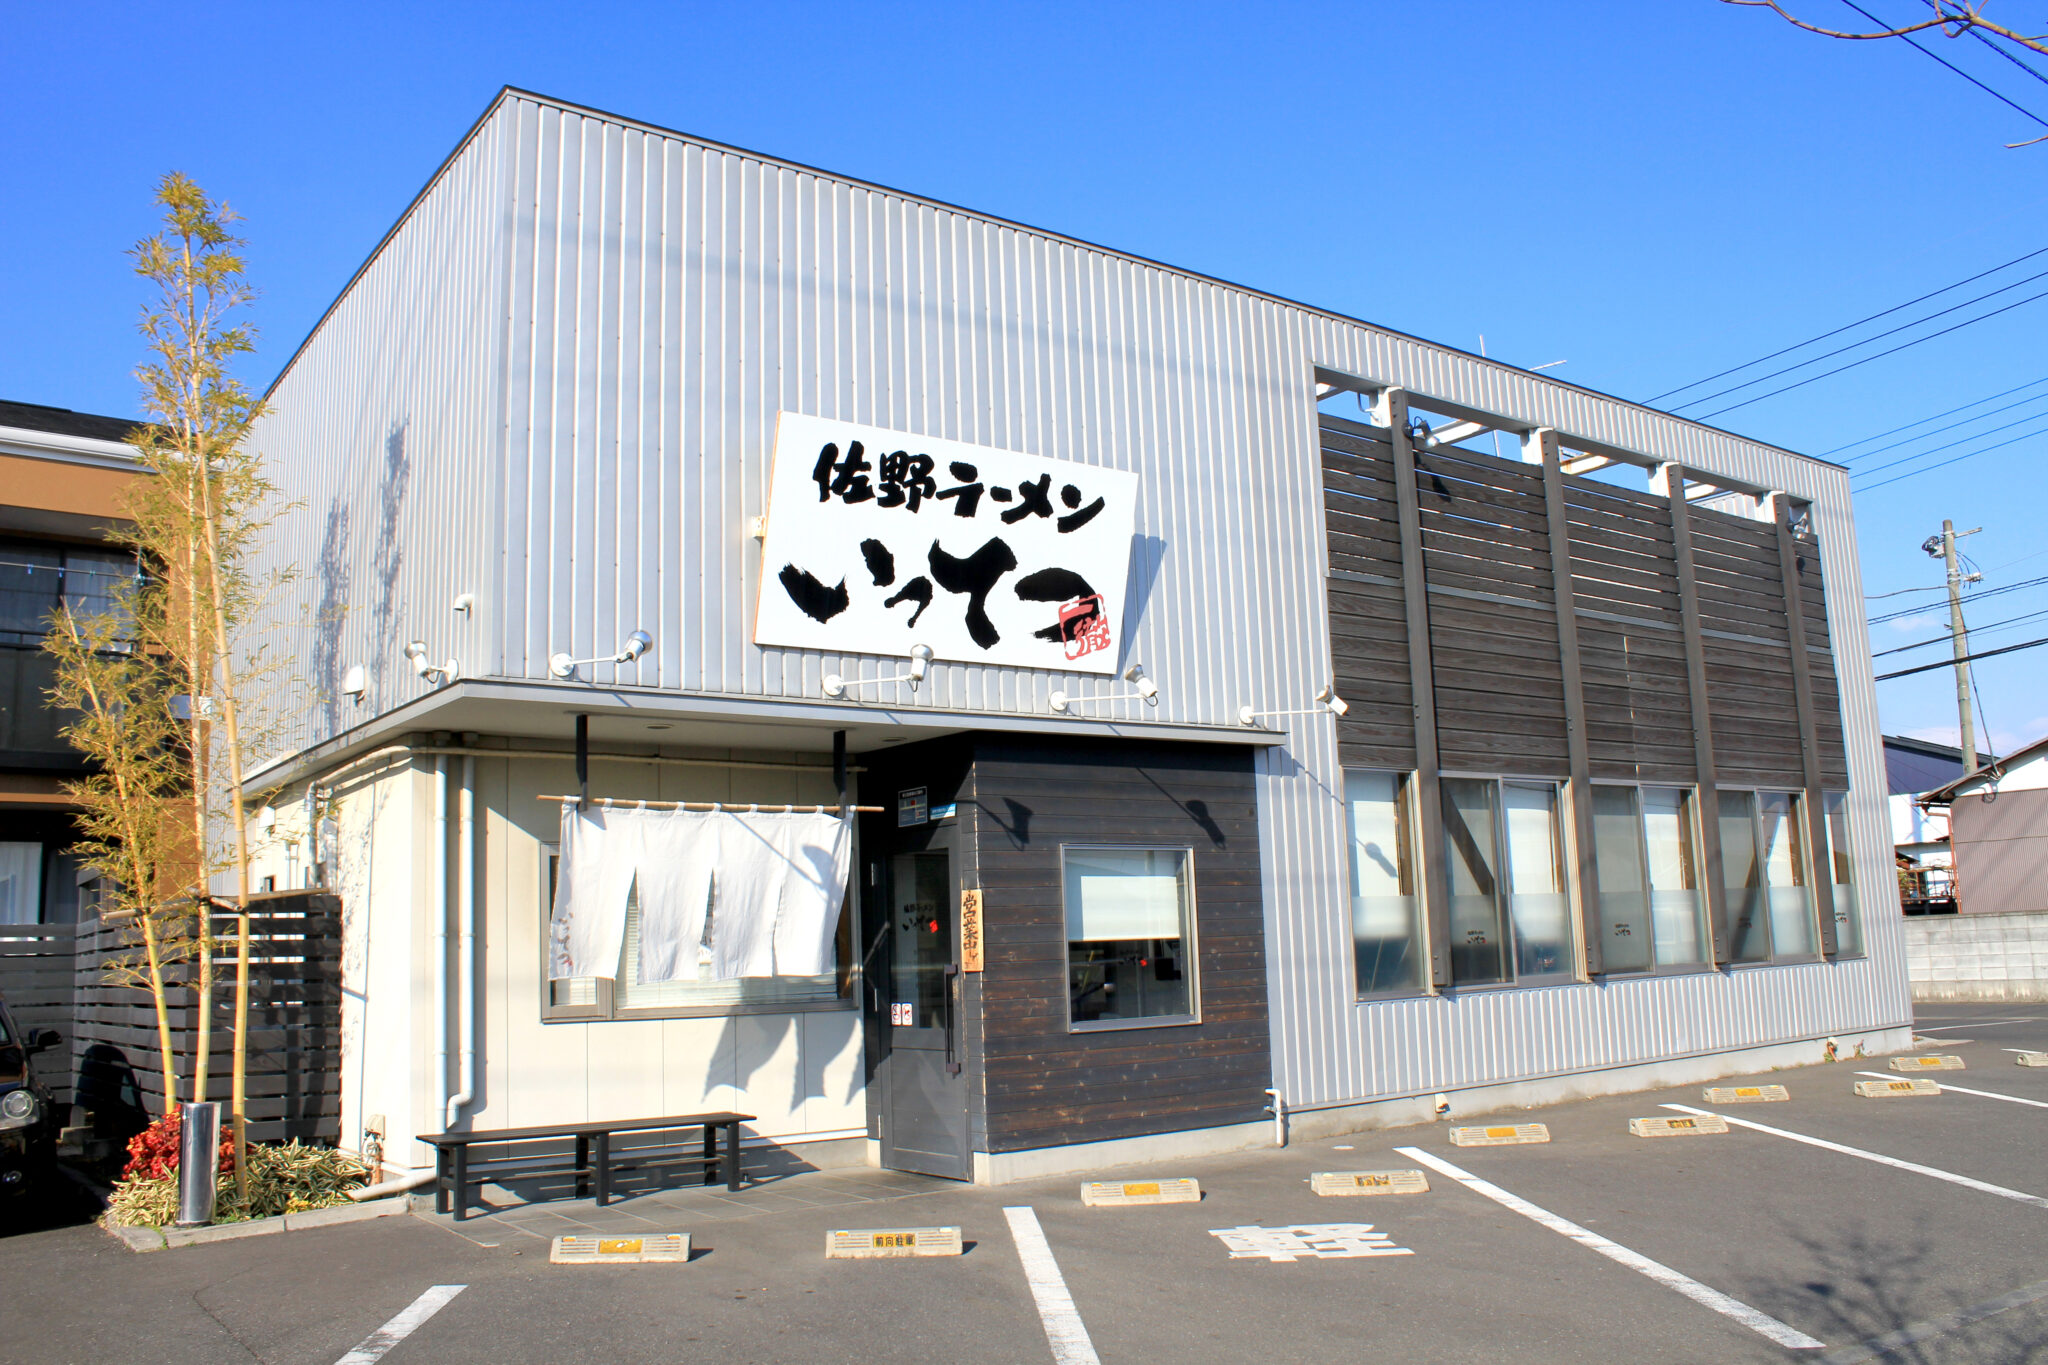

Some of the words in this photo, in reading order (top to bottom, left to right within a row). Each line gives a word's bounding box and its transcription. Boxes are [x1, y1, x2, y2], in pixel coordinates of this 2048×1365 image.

[812, 440, 1105, 534] 佐野ラーメン
[778, 536, 1102, 651] いってつ
[962, 893, 979, 952] 営業中
